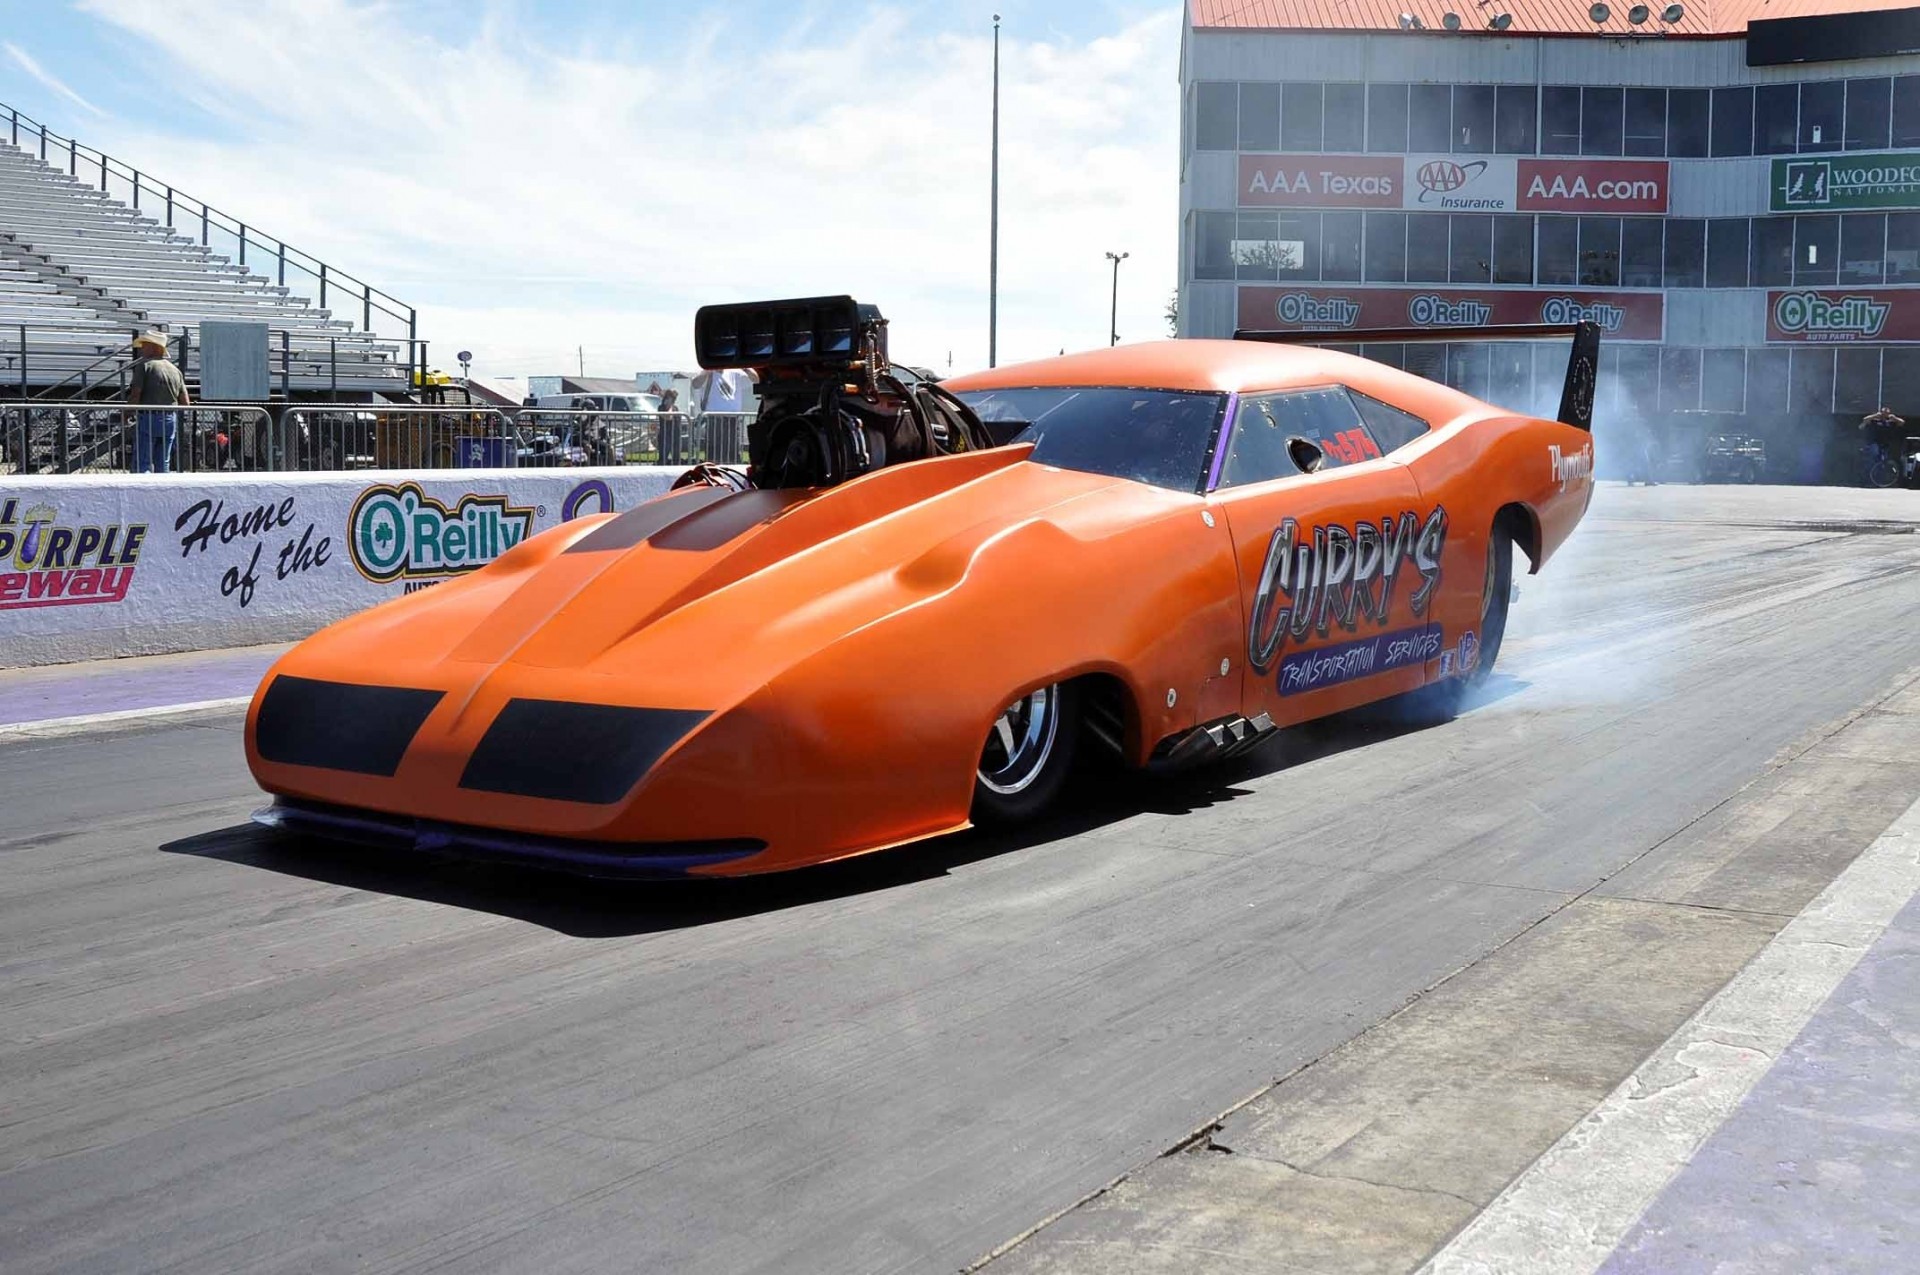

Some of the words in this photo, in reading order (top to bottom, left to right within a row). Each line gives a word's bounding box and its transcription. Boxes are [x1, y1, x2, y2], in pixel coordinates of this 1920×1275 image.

[1249, 170, 1312, 194] AAA
[1320, 171, 1392, 196] Texas
[1527, 175, 1658, 200] AAA.com
[1440, 196, 1504, 210] Insurance
[1279, 294, 1359, 325] O'Reilly
[1411, 296, 1489, 326] O'Reilly
[1544, 299, 1621, 331] O'Reilly
[1779, 294, 1883, 332] O'Reilly
[1806, 333, 1828, 341] AUTO
[1829, 333, 1855, 341] PARTS
[175, 497, 296, 558] Home
[358, 494, 524, 570] O'Reilly
[221, 541, 260, 608] of
[277, 523, 332, 581] the
[1250, 505, 1446, 670] CURRY'S
[1279, 638, 1380, 691] TRANSPORTATION
[1385, 632, 1440, 665] SERVICES
